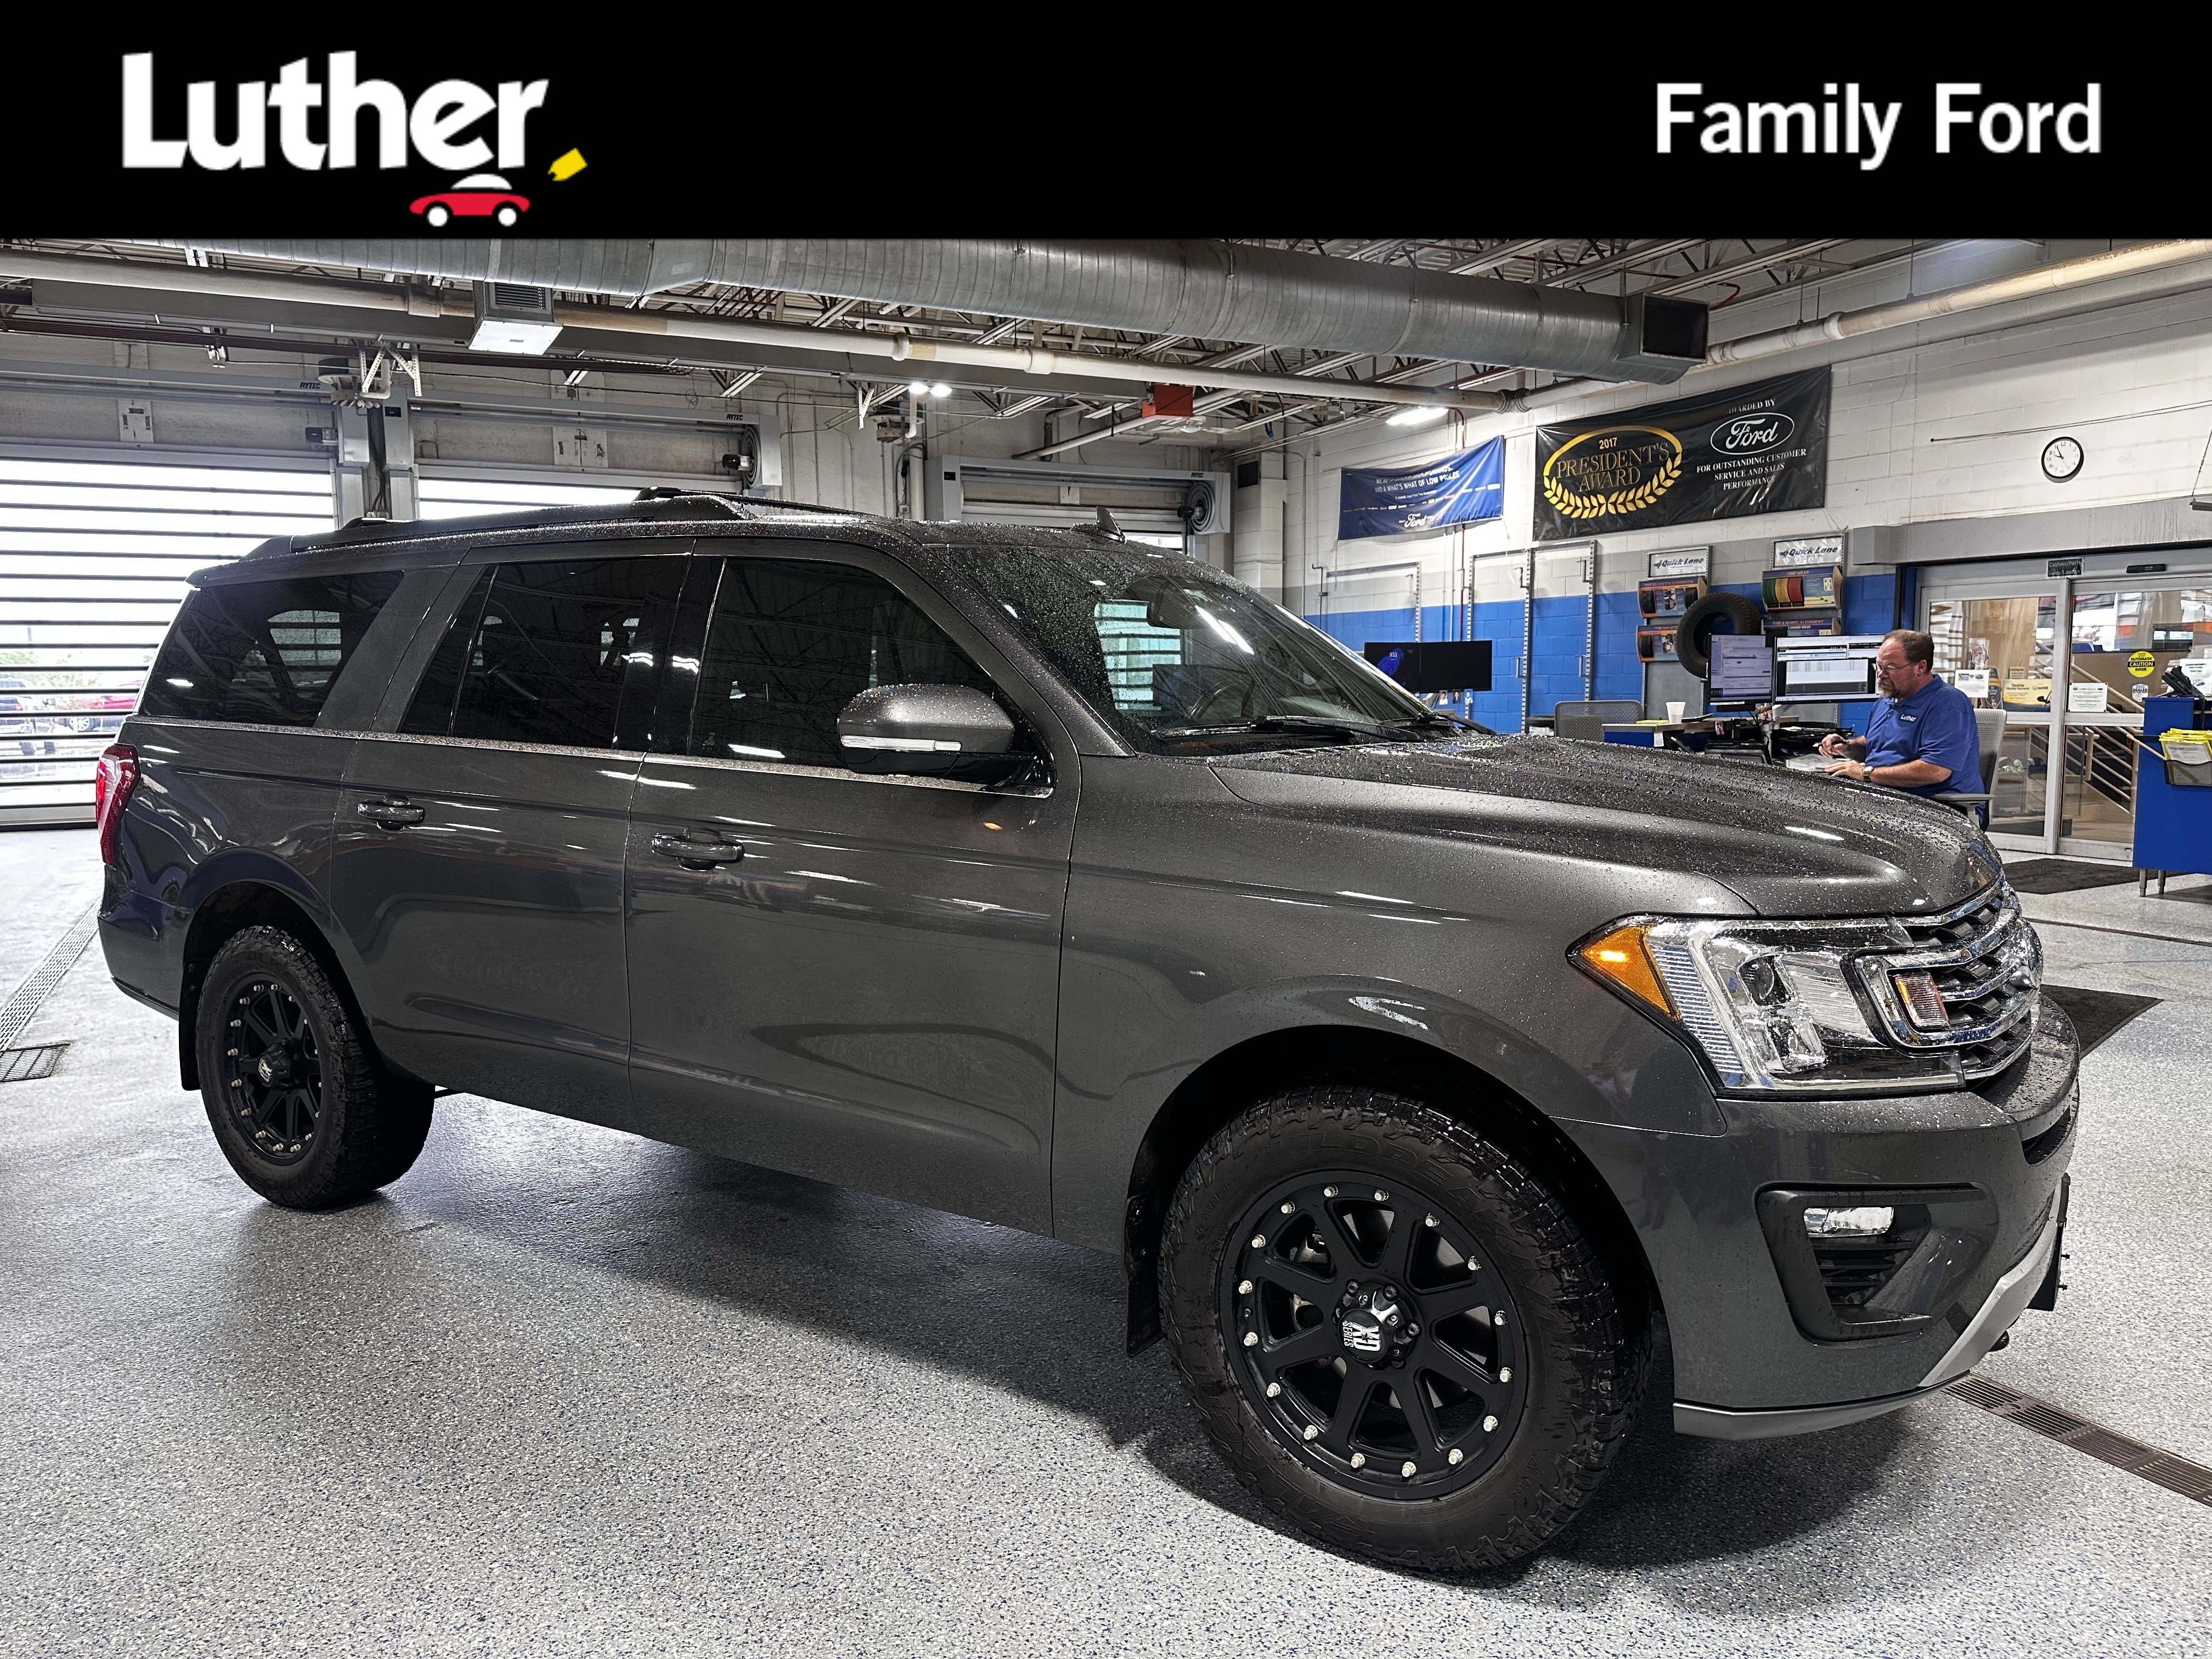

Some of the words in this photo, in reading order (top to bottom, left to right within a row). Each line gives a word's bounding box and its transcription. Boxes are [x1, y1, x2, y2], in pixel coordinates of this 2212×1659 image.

[1729, 401, 1763, 414] AWARDED
[1765, 399, 1776, 407] BY
[1725, 418, 1779, 449] Ford
[1599, 437, 1617, 449] 2017
[1556, 442, 1669, 479] PRESIDENT'S
[1697, 464, 1711, 473] FOR
[1713, 456, 1764, 471] OUTSTANDING
[1767, 448, 1807, 462] CUSTOMER
[1577, 467, 1640, 493] AWARD
[1714, 470, 1746, 481] SERVICE
[1748, 467, 1763, 476] AND
[1764, 462, 1785, 473] SALES
[1386, 483, 1403, 492] WHAT'S
[1403, 481, 1417, 489] WHAT
[1426, 476, 1438, 485] LOW
[1723, 475, 1776, 490] PERFORMANCE
[1404, 513, 1427, 527] Ford
[1789, 548, 1814, 556] Quick
[1662, 558, 1683, 567] Quick
[1342, 1321, 1354, 1347] SERIES
[1352, 1322, 1381, 1351] XD
